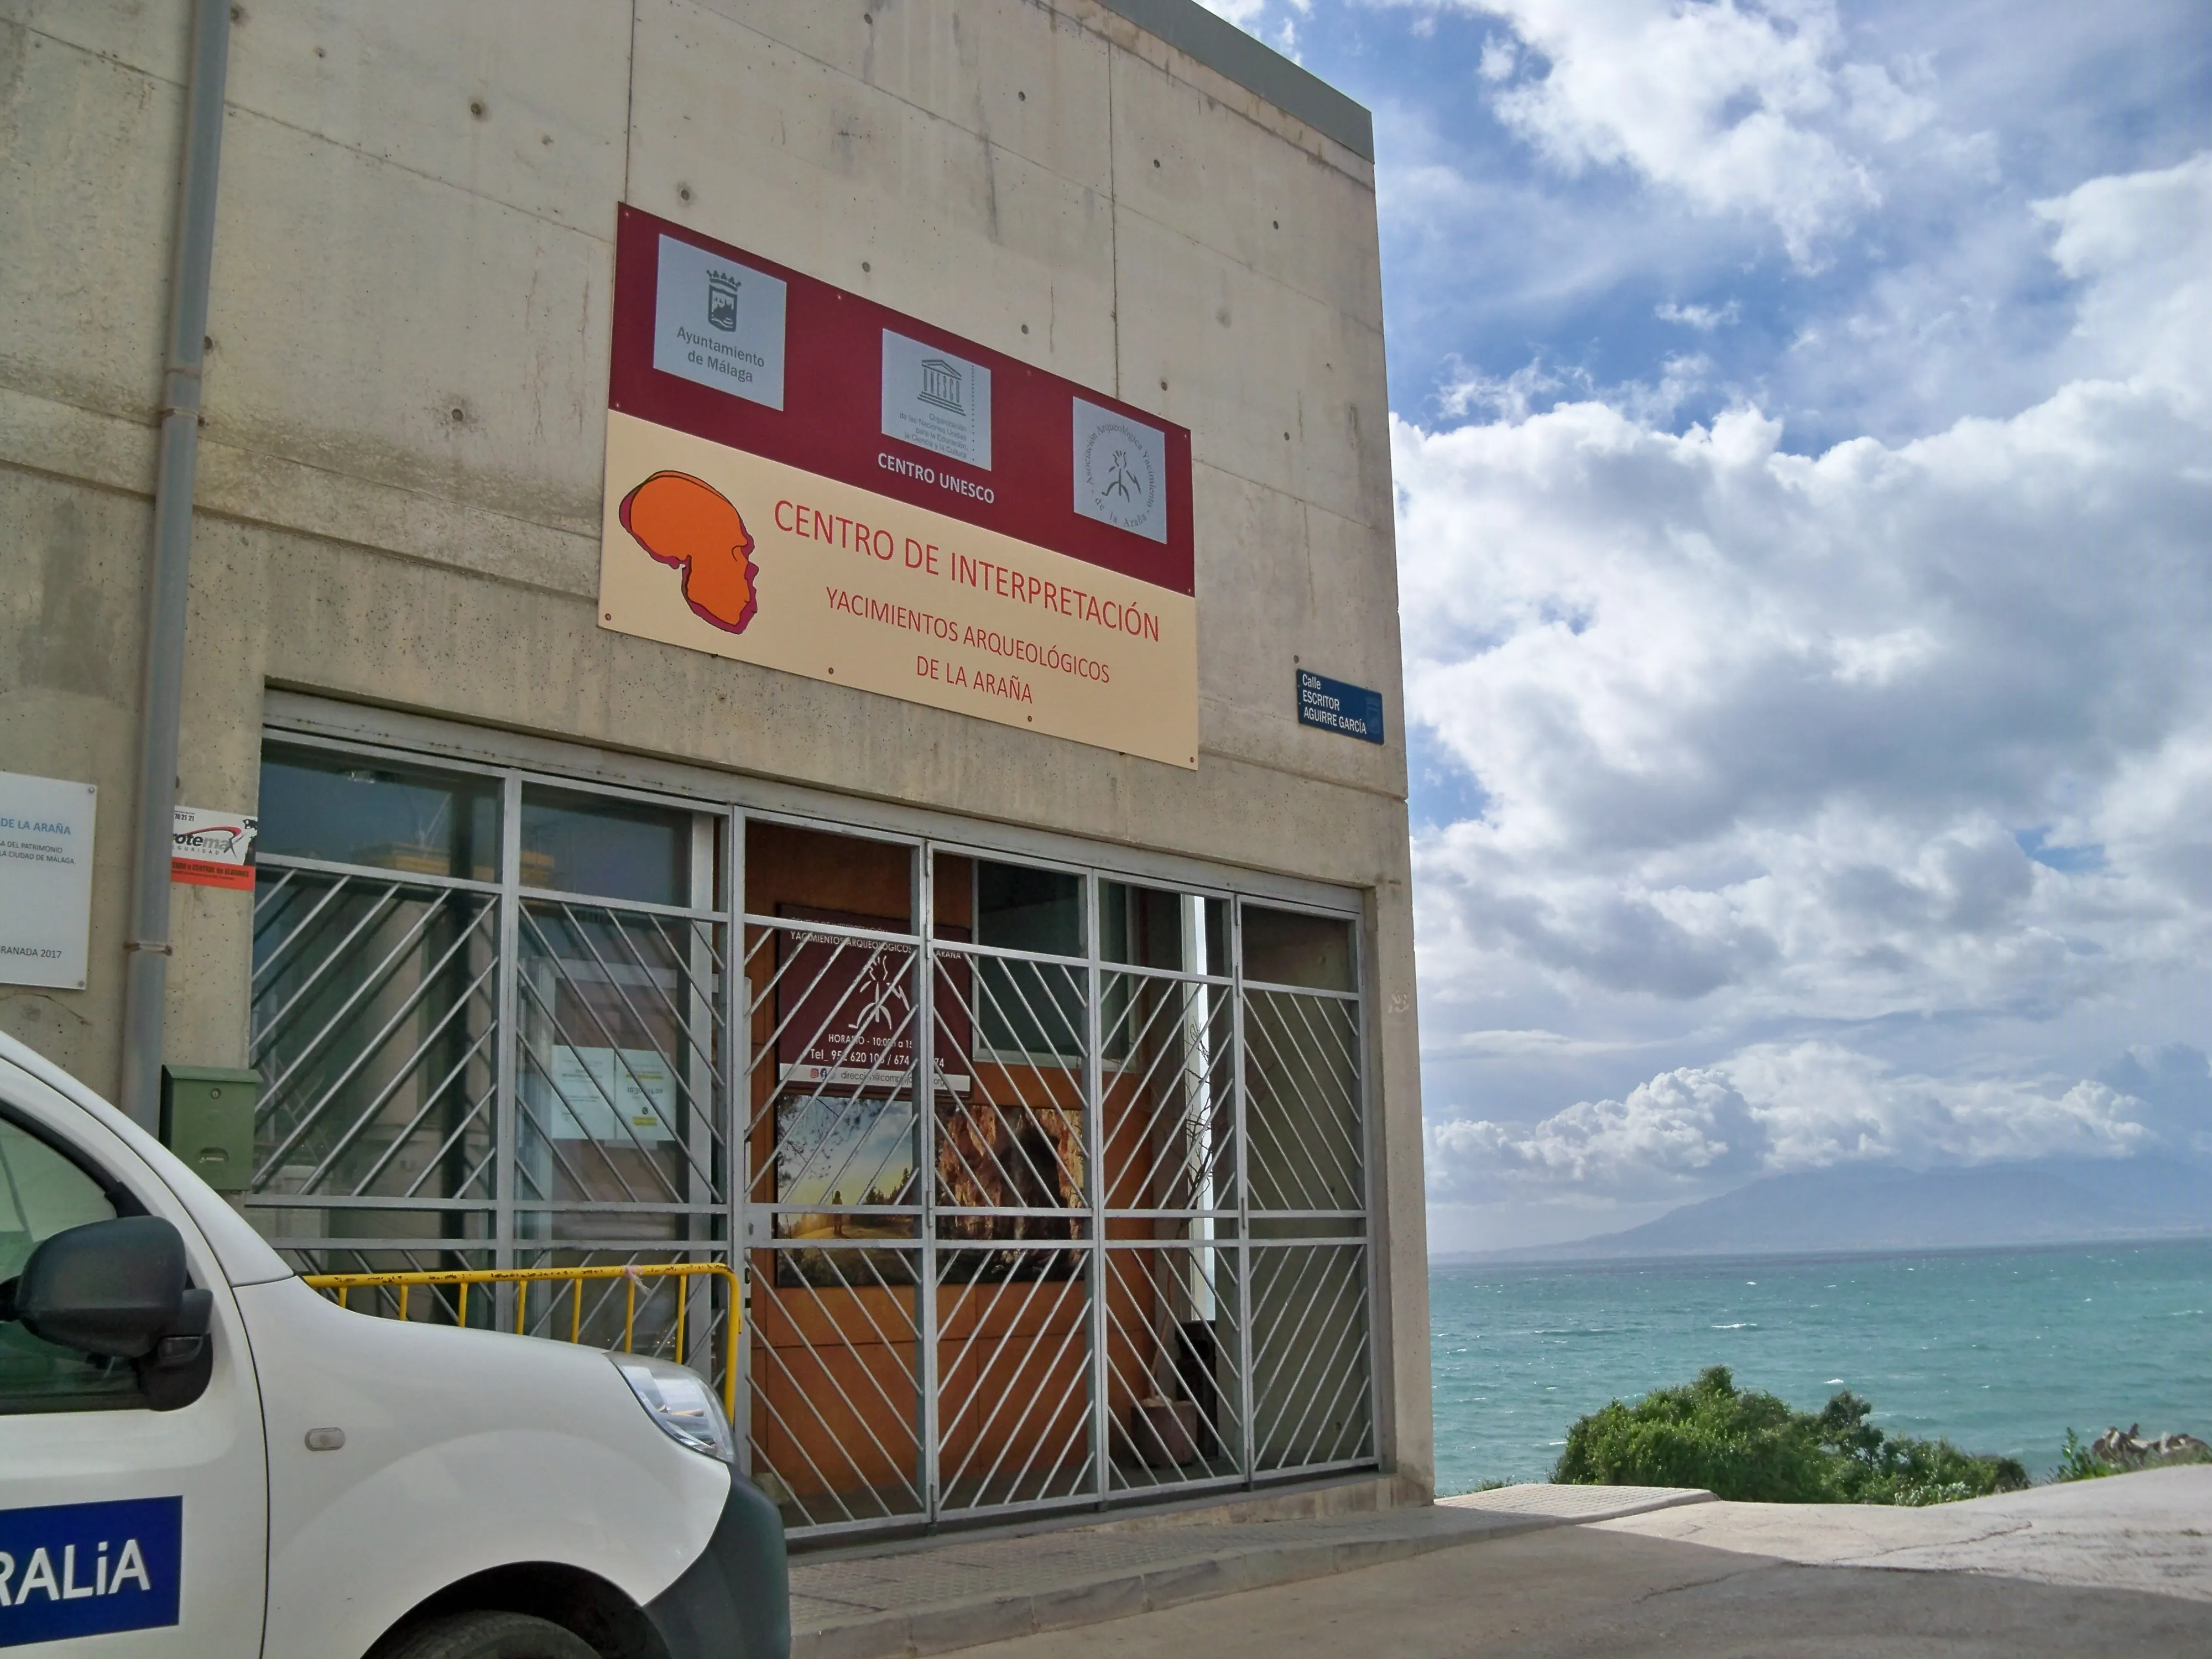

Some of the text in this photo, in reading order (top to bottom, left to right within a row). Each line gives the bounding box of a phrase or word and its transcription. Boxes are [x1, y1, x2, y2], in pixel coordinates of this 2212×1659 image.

[677, 326, 764, 367] Ayuntamiento
[688, 351, 752, 382] de Málaga
[878, 453, 994, 503] CENTRO UNESCO
[775, 500, 1159, 642] CENTRO DE INTERPRETACIÓN
[826, 587, 1110, 684] YACIMIENTOS ARQUEOLÓGICOS
[917, 656, 1033, 705] DE LA ARAÑA
[1302, 674, 1321, 690] Calle
[1303, 690, 1340, 711] ESCRITOR
[1304, 707, 1367, 734] AGUIRRE GARCÍA
[1, 818, 71, 835] DE LA ARAÑA
[8, 851, 35, 860] CIUDAD
[21, 843, 63, 853] PATRIMONIO
[0, 946, 61, 958] RANADA 2017
[832, 1050, 848, 1061] 95
[851, 1052, 867, 1062] 620
[894, 1055, 910, 1065] 674
